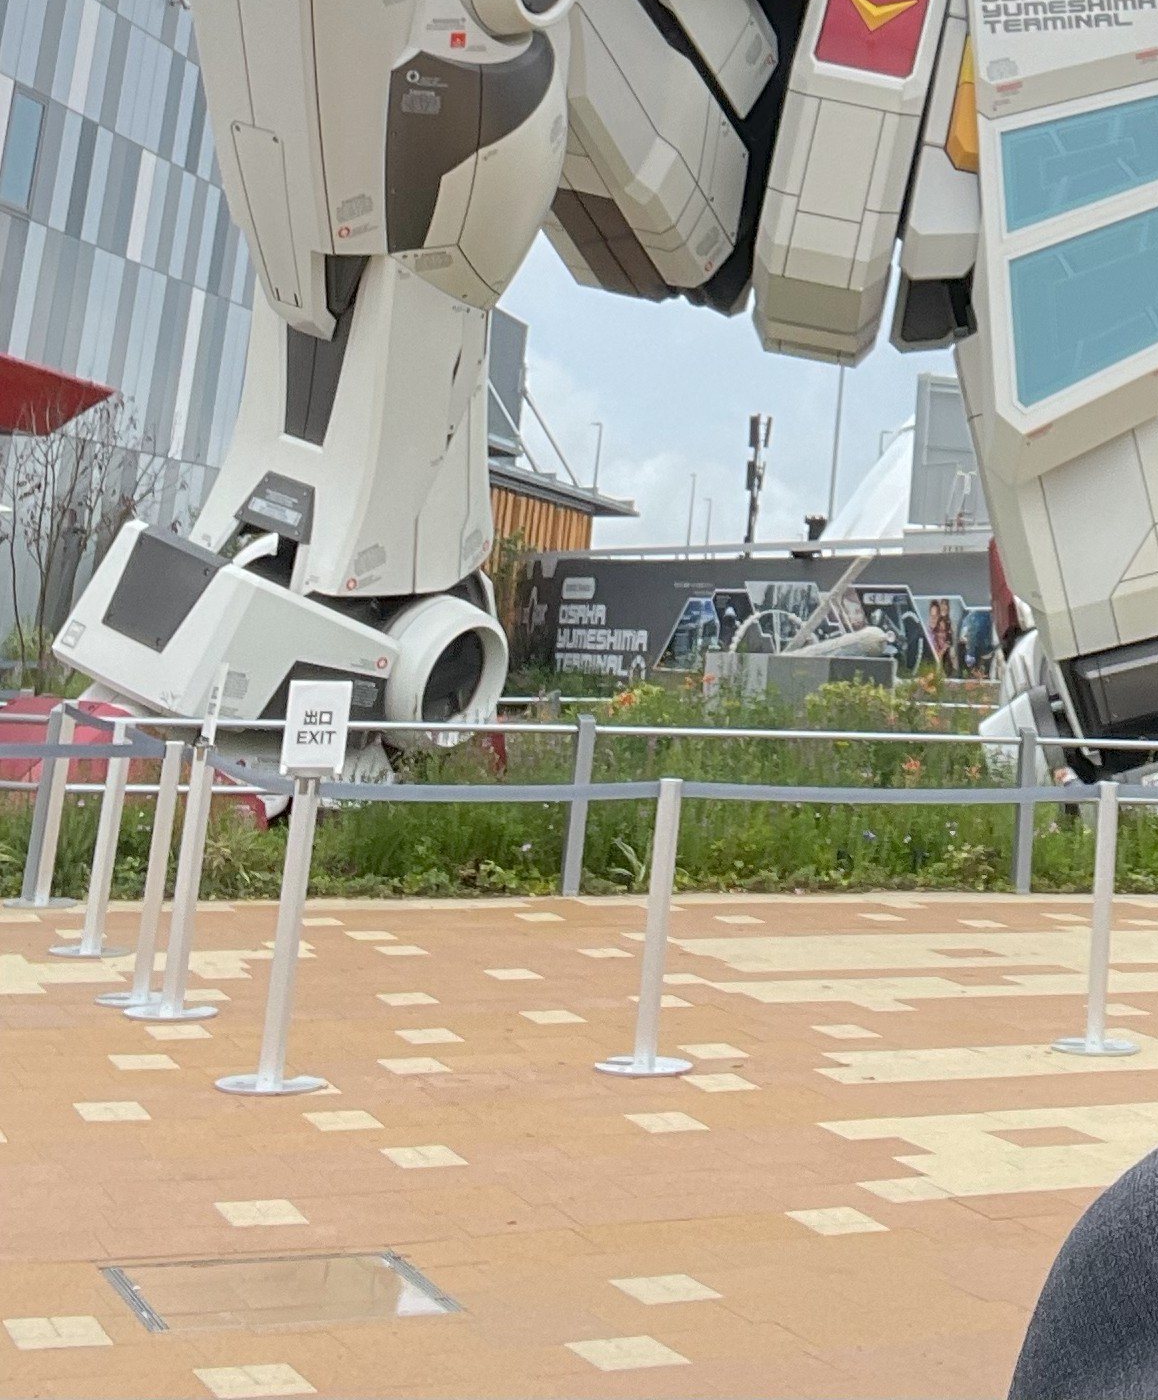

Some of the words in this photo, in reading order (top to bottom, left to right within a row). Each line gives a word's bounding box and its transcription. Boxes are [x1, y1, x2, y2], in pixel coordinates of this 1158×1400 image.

[983, 12, 1134, 34] TERMINAL
[559, 604, 606, 625] OSAKA
[556, 628, 648, 652] YUMESHIMA
[303, 708, 334, 726] 出口
[295, 730, 337, 745] EXIT
